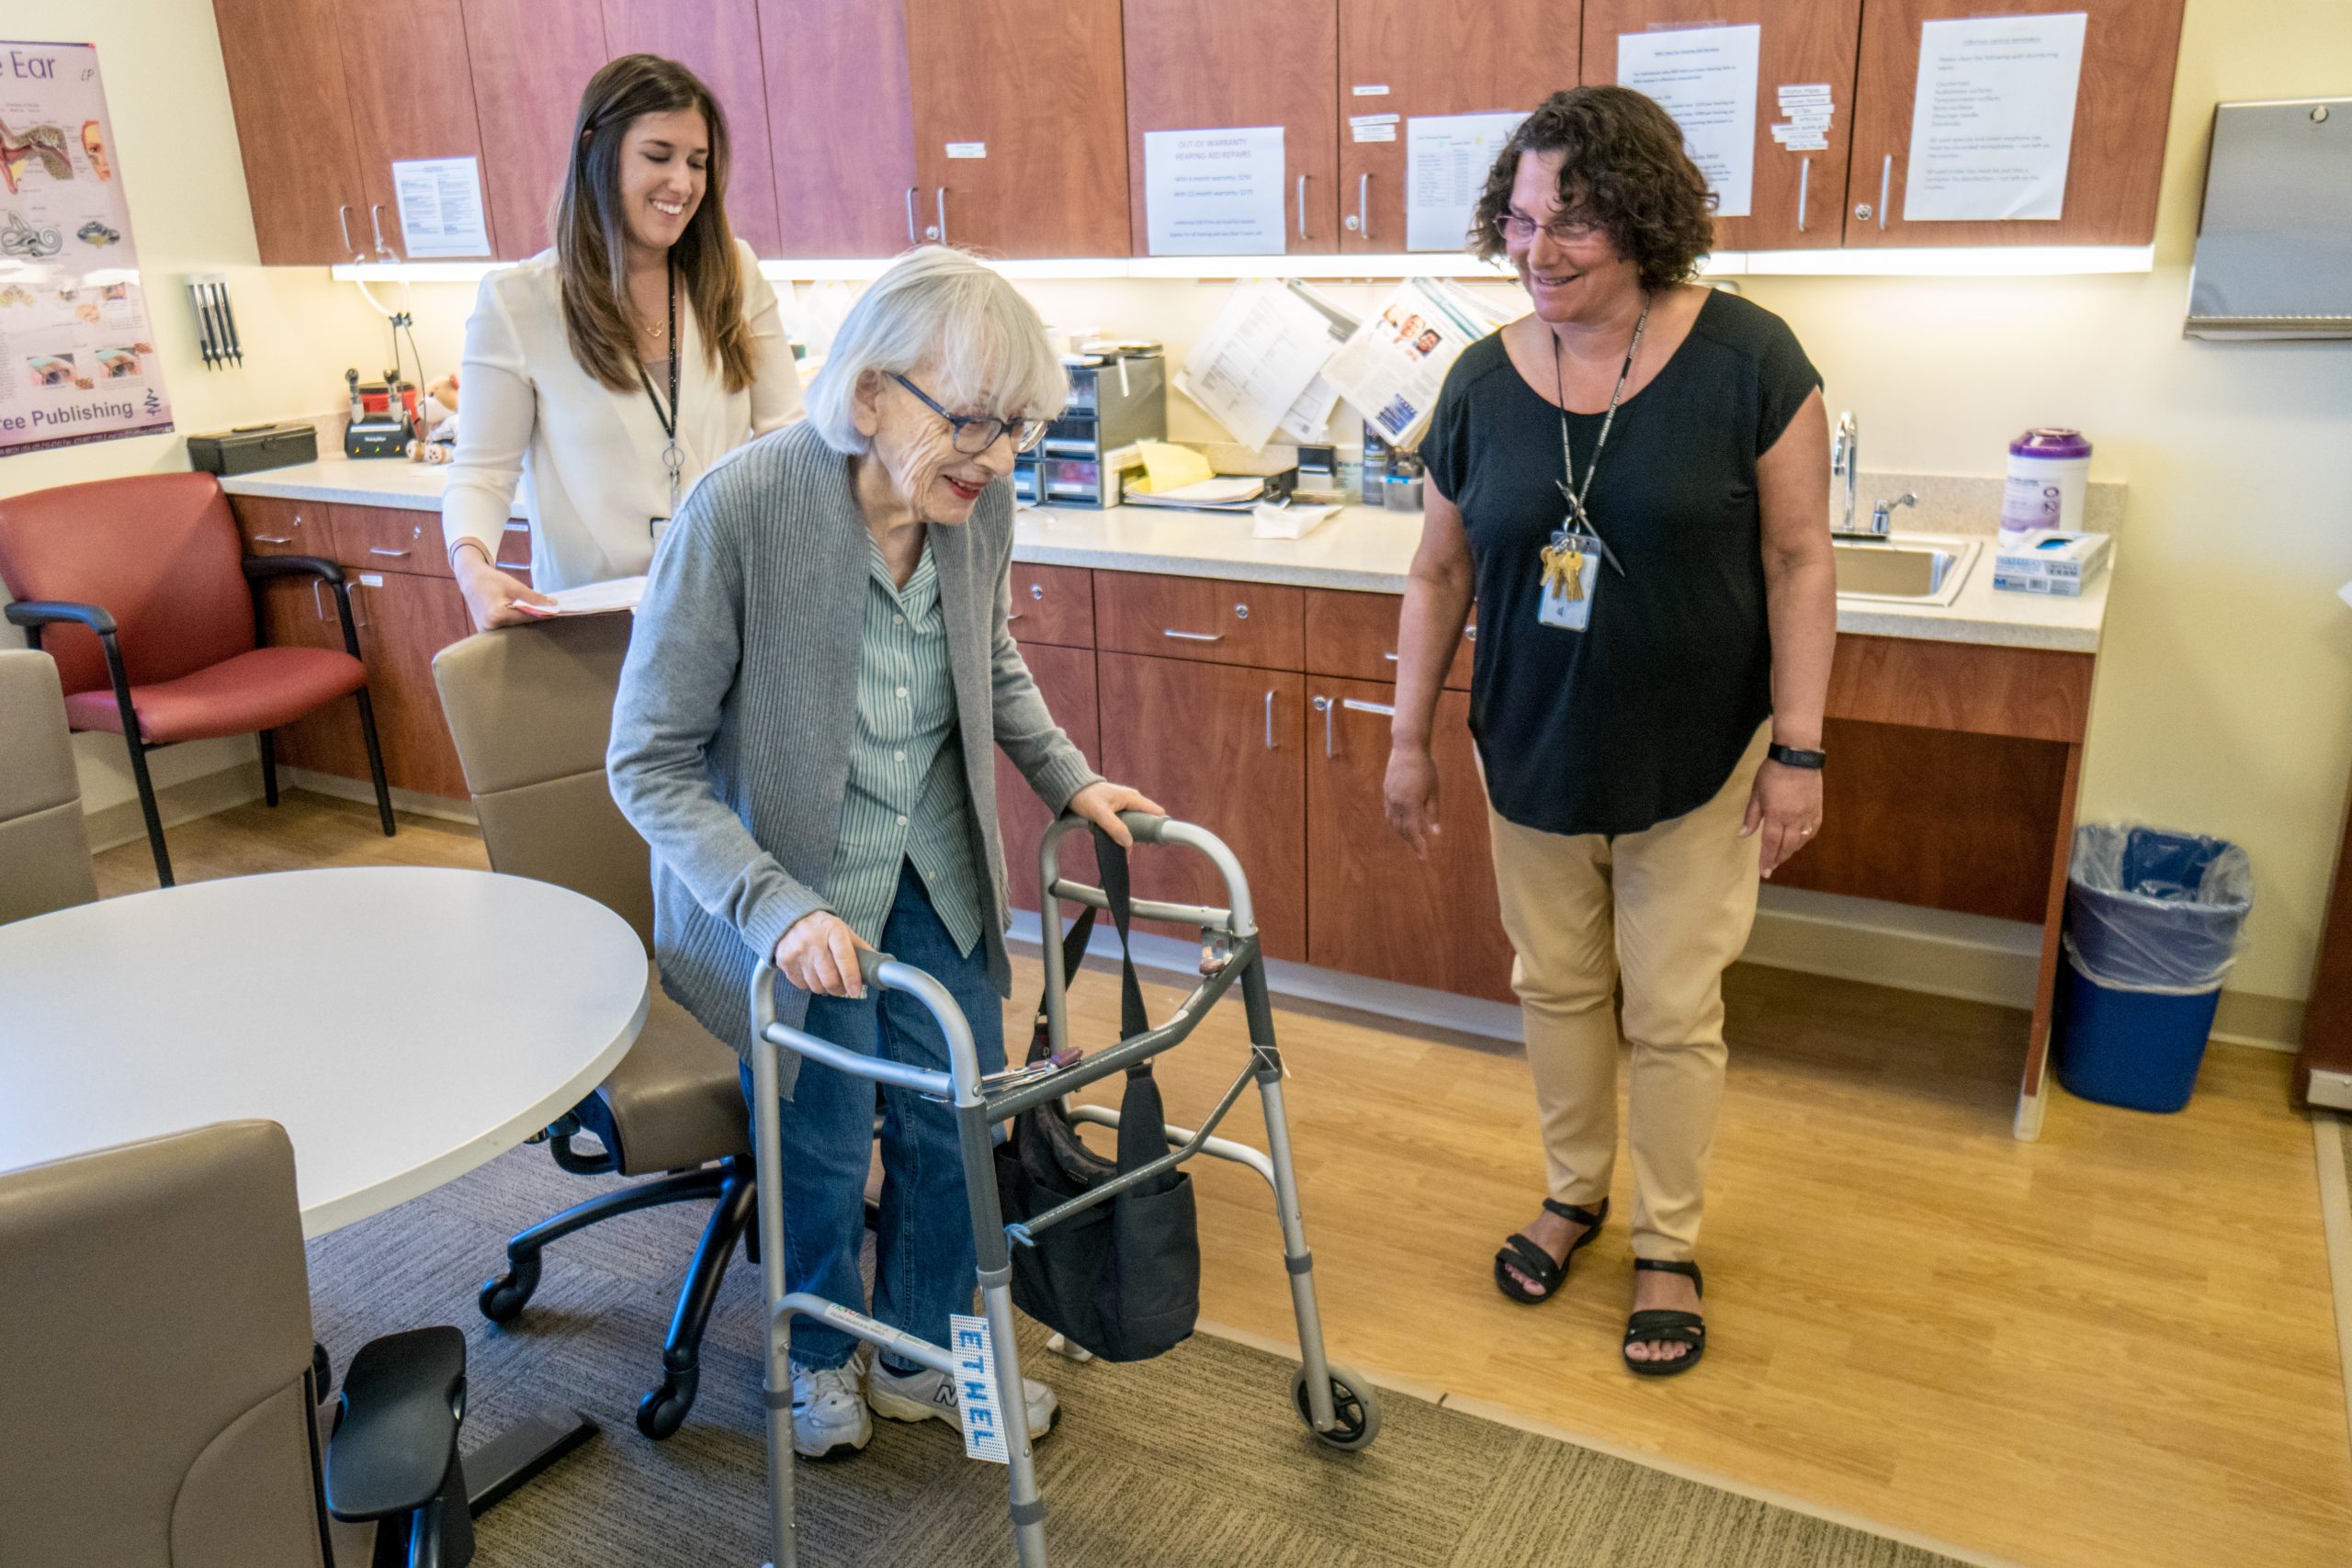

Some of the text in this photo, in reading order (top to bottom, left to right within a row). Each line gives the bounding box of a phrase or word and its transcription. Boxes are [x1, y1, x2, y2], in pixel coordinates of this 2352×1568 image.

[10, 51, 55, 79] Ear
[1175, 151, 1251, 161] HEARING AID REPAIRS
[1206, 139, 1248, 148] WARRANTY
[31, 401, 133, 427] Publishing
[959, 1330, 995, 1447] ETHEL
